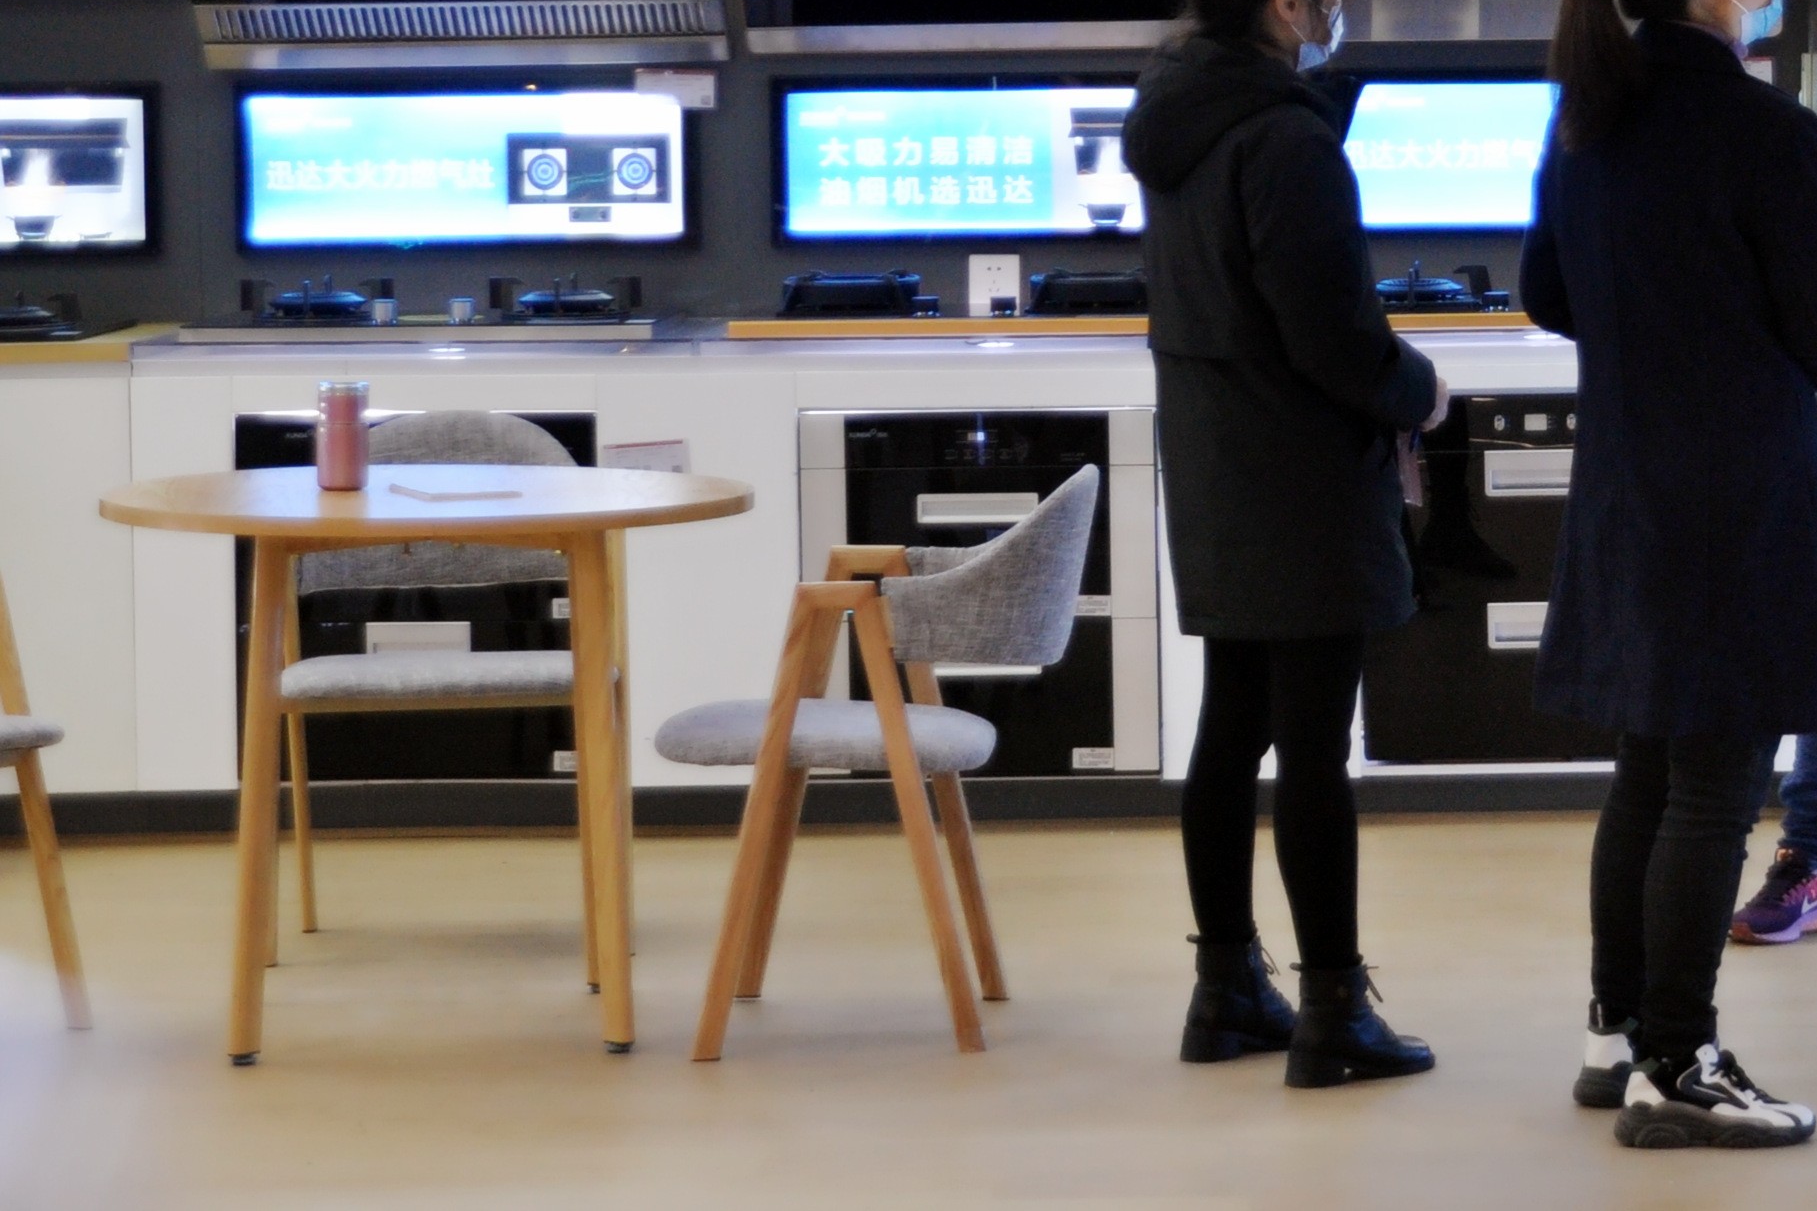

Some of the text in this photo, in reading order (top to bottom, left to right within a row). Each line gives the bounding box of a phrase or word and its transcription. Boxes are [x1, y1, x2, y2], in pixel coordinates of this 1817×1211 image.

[818, 136, 1034, 167] 大吸力易清洁
[819, 175, 1034, 207] 油烟机选迅达
